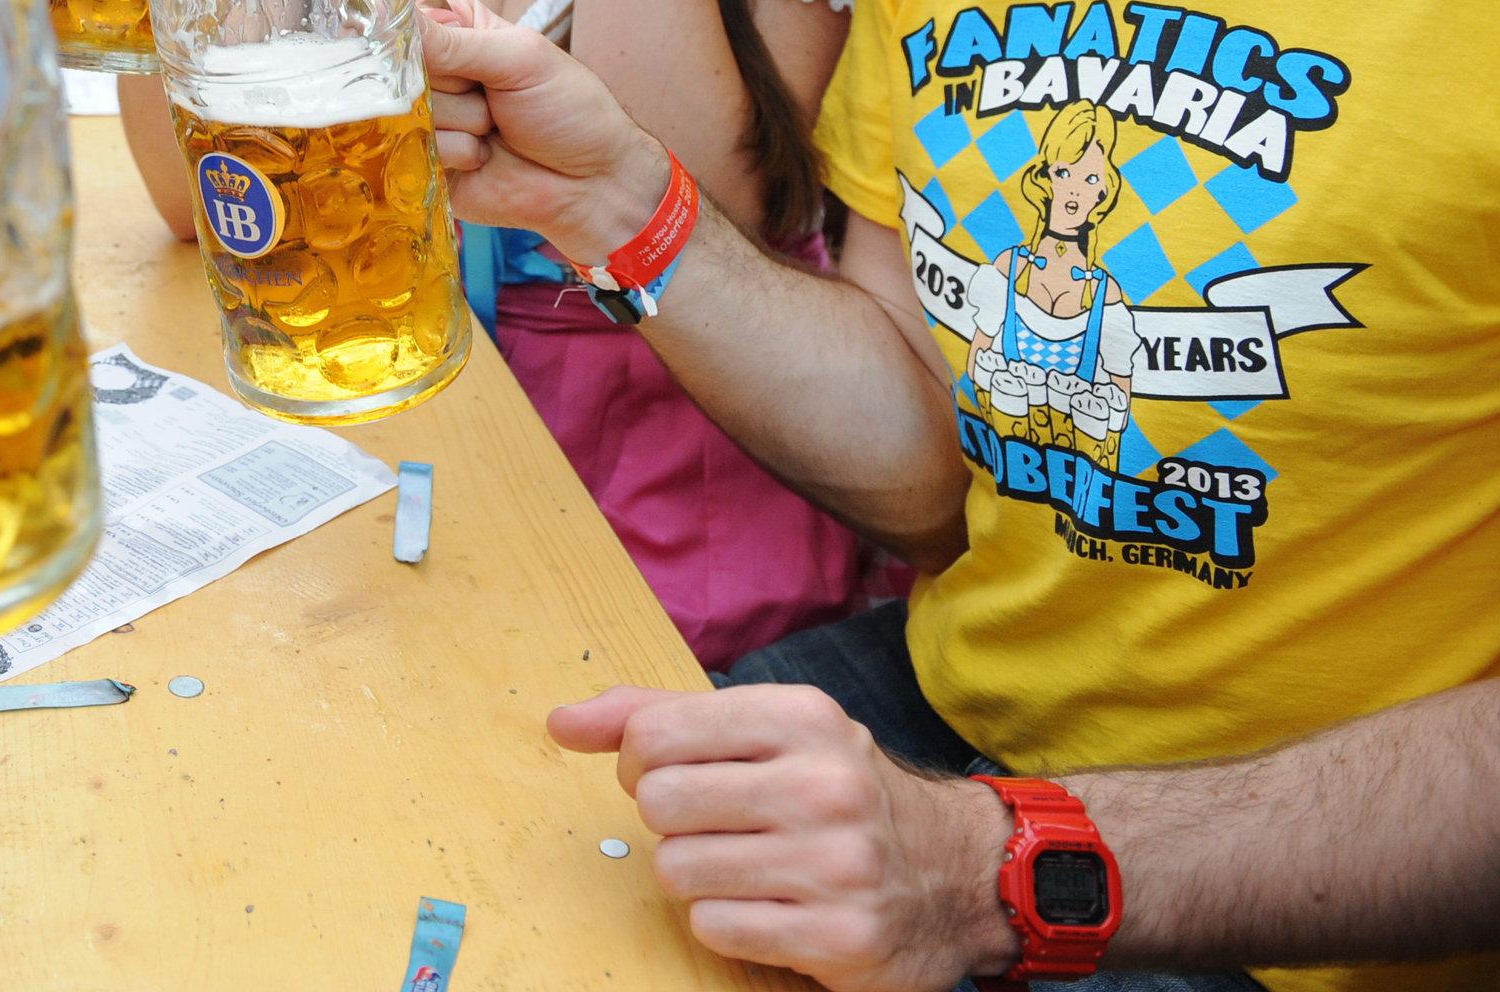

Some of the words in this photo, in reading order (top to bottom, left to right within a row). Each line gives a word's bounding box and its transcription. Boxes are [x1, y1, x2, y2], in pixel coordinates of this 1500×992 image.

[903, 0, 1350, 129] FANATICS
[944, 80, 976, 117] IN
[977, 55, 1293, 181] BAVARIA
[213, 199, 261, 242] HB
[642, 206, 688, 267] Oktoberfest
[915, 251, 965, 311] 203
[1141, 336, 1267, 374] YEARS
[957, 410, 1254, 565] KTOBERFEST
[1162, 461, 1261, 501] 2013
[1054, 512, 1113, 563] MICH,
[1121, 544, 1254, 590] GERMANY
